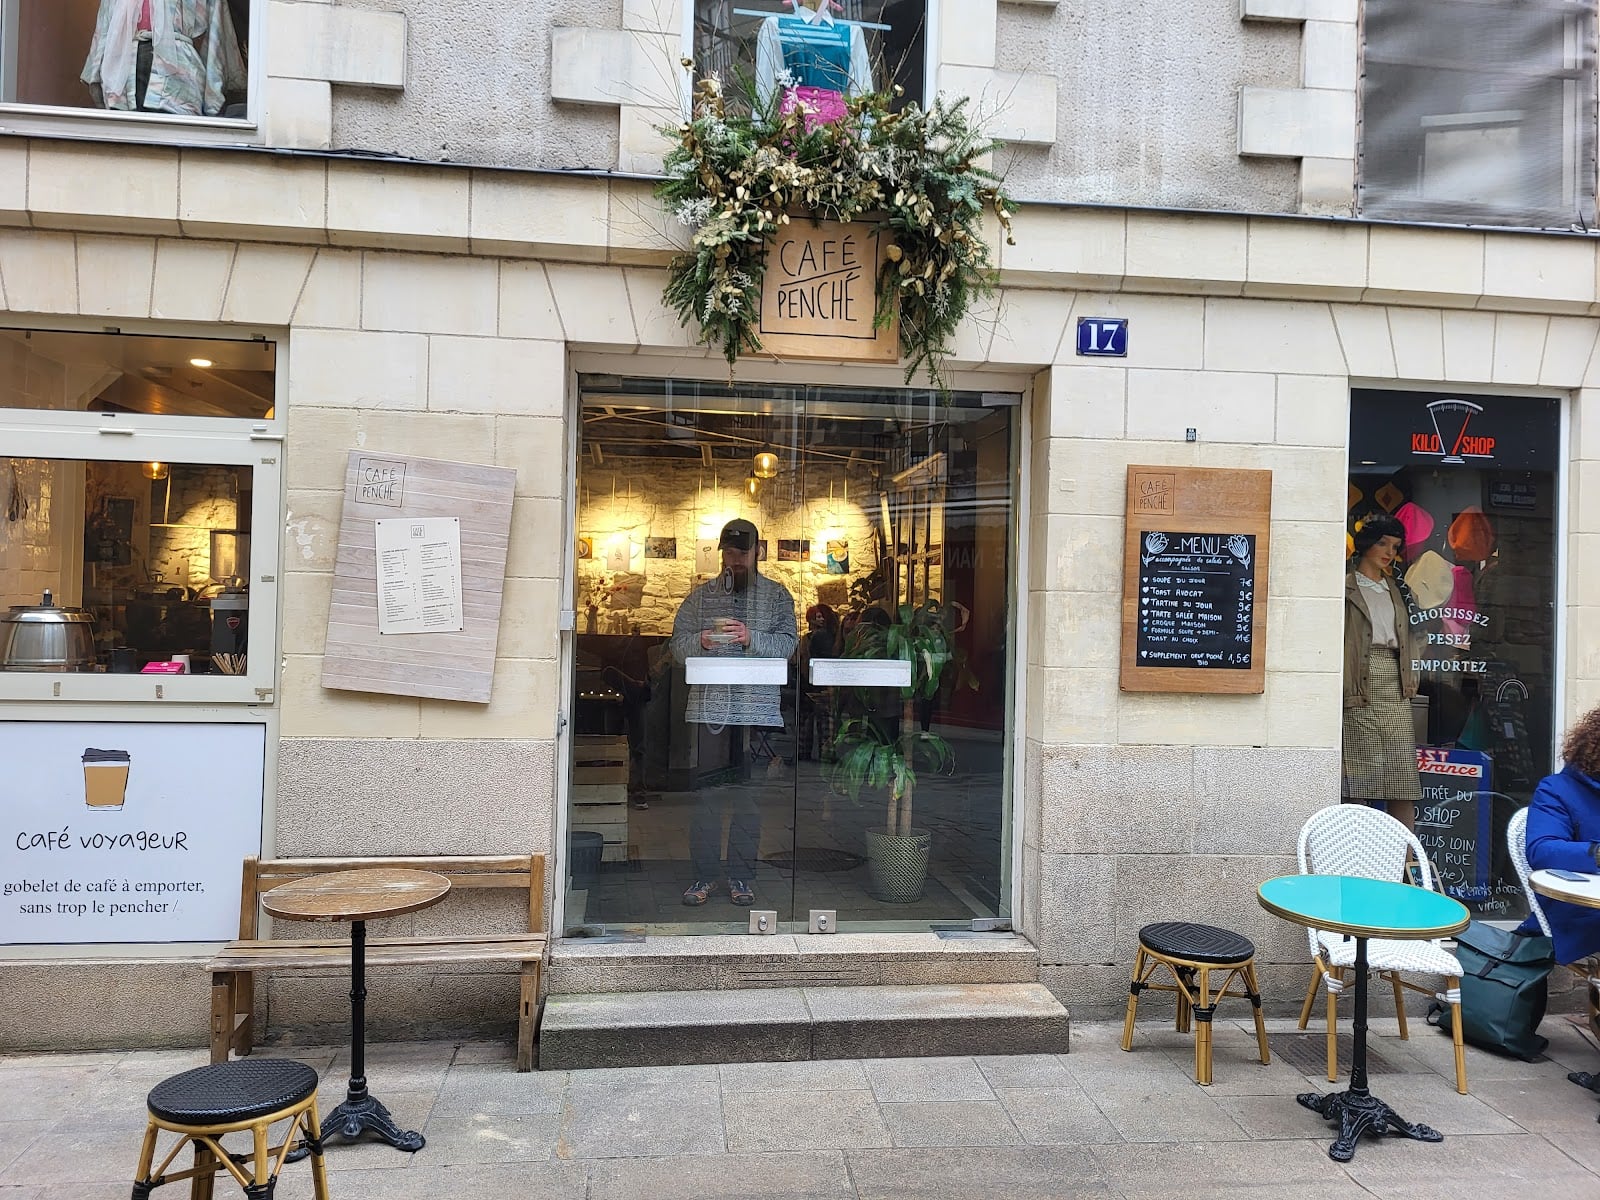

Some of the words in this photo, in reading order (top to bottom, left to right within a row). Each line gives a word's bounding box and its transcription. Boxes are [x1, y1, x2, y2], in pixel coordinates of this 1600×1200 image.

[780, 234, 857, 277] CAFÉ
[778, 272, 860, 321] PENCHÉ
[1088, 323, 1119, 351] 17
[1412, 433, 1440, 452] KILO
[1461, 436, 1495, 455] SHOP
[365, 467, 397, 482] CAFÉ
[362, 482, 397, 501] PENCHÉ
[1140, 479, 1169, 495] CAFÉ
[1139, 493, 1169, 510] PENCHÉ
[1239, 577, 1253, 587] 7€
[1150, 586, 1171, 596] TOAST
[1175, 589, 1204, 597] AVOCAT
[1239, 591, 1253, 601] 9€
[1151, 598, 1179, 608] TARTINE
[1195, 602, 1213, 610] JOUR
[1238, 602, 1252, 612] 9€
[1150, 610, 1172, 618] TARTE
[1198, 613, 1223, 621] MAISON
[1236, 613, 1250, 623] 9€
[1409, 607, 1490, 627] CHOISISSEZ
[1151, 627, 1175, 635] FORMULE
[1236, 624, 1250, 632] 9€
[1427, 633, 1472, 645] PESEZ
[1149, 651, 1187, 660] SUPPLEMENT
[1411, 659, 1488, 673] EMPORTEZ
[1415, 749, 1449, 762] EST
[1456, 790, 1473, 801] DU
[1423, 806, 1461, 824] SHOP
[1419, 833, 1446, 848] PLUS
[1449, 836, 1475, 851] LOIN
[1445, 852, 1472, 866] RUE
[4, 879, 59, 896] gobelet
[63, 879, 82, 893] de
[86, 879, 118, 893] café
[121, 879, 130, 893] à
[134, 880, 205, 896] emporter,
[19, 902, 52, 914] sans
[57, 901, 87, 916] trop
[92, 900, 105, 914] le
[109, 899, 169, 916] pencher
